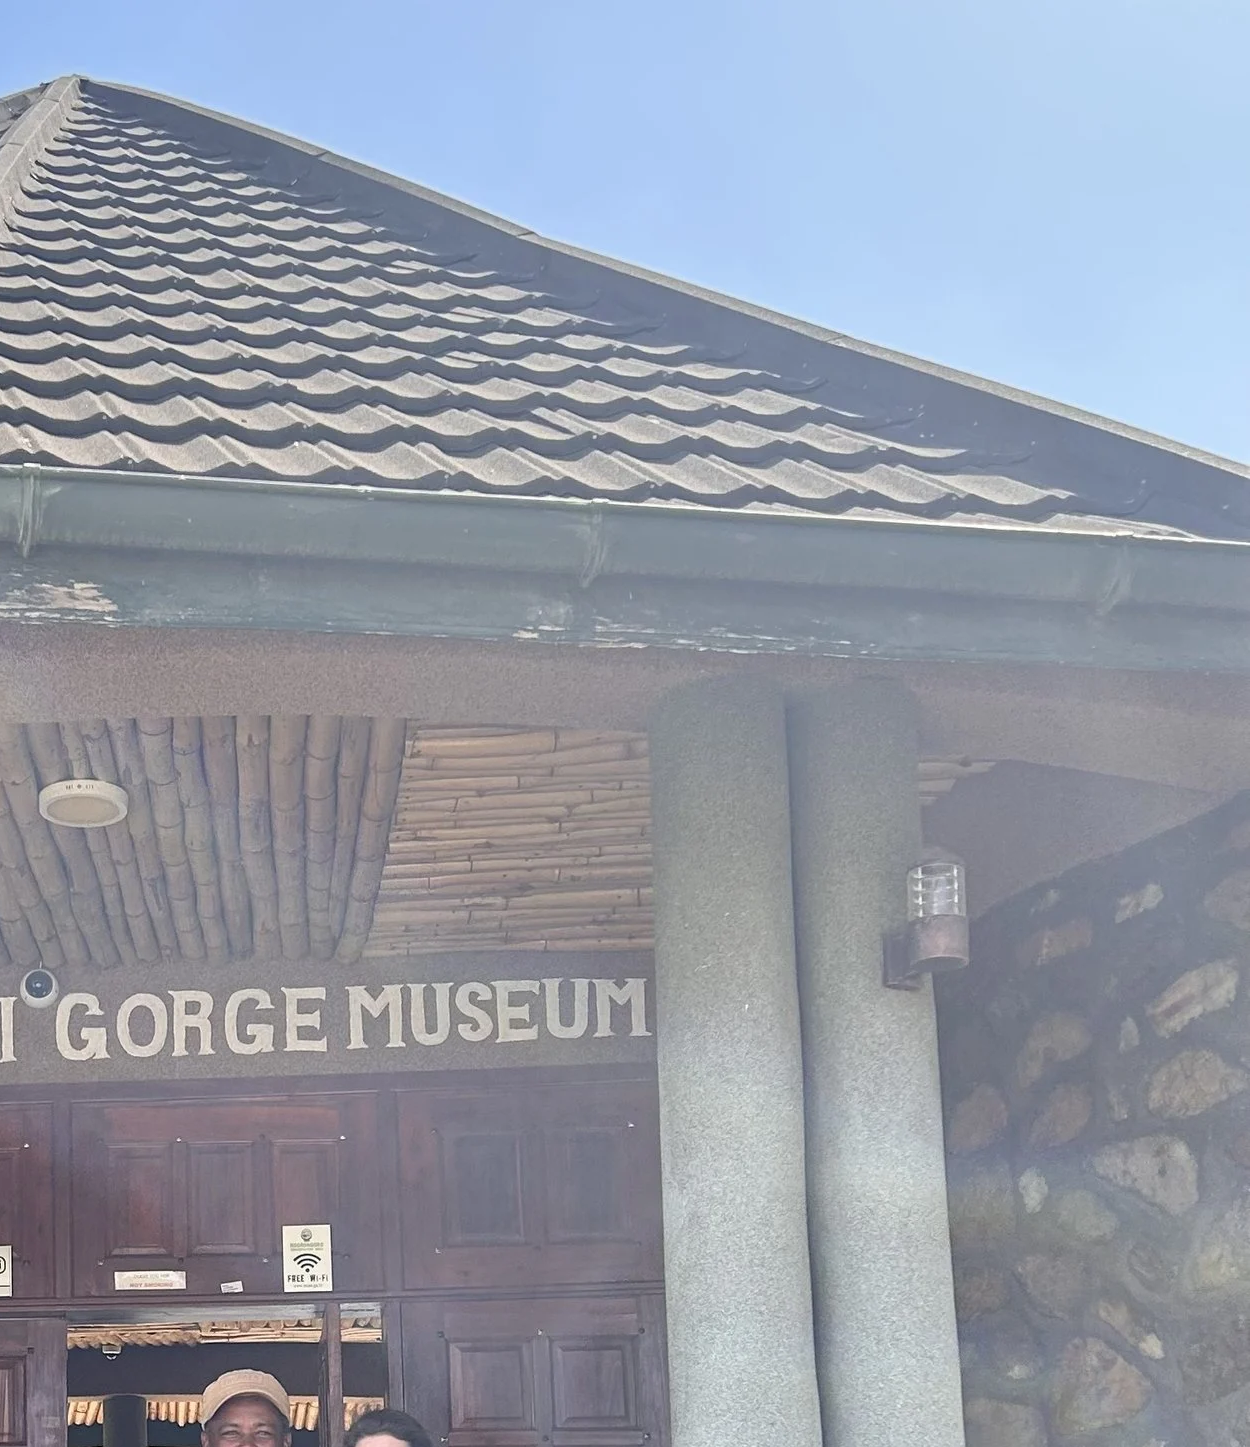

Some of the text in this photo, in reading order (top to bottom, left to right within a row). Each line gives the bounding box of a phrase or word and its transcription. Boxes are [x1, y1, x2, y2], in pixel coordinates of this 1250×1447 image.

[55, 987, 328, 1060] GORGE
[344, 978, 652, 1049] MUSEUM
[287, 1274, 305, 1283] FREE
